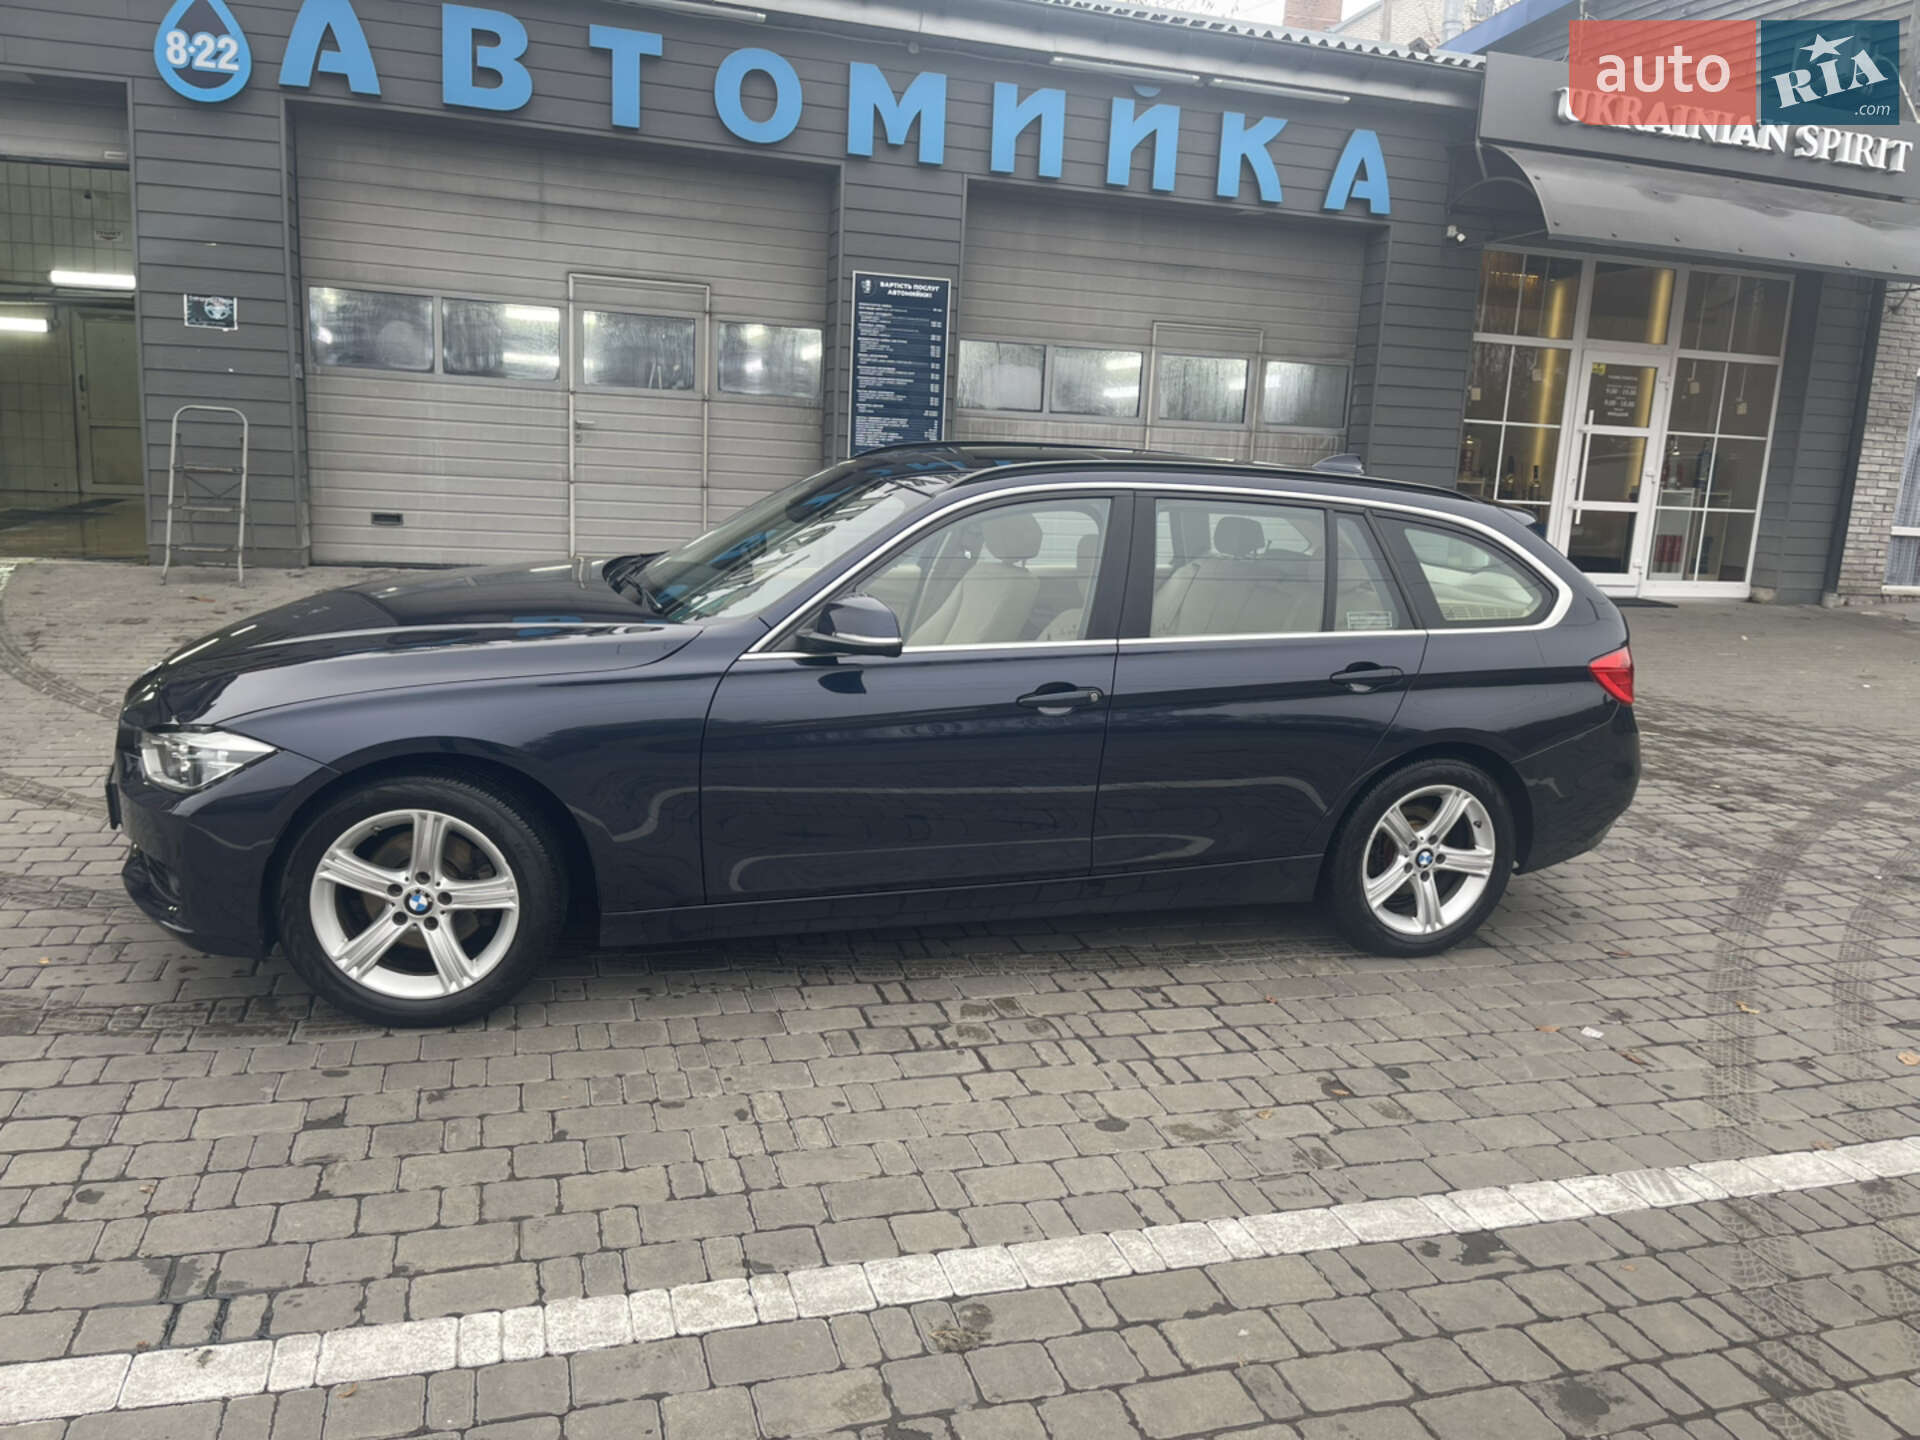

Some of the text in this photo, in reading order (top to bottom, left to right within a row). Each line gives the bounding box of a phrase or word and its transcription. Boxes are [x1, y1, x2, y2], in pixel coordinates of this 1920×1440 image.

[279, 0, 1392, 215] АВТОМИЙКА
[1554, 87, 1913, 172] UKRAINIAN SPIRIT
